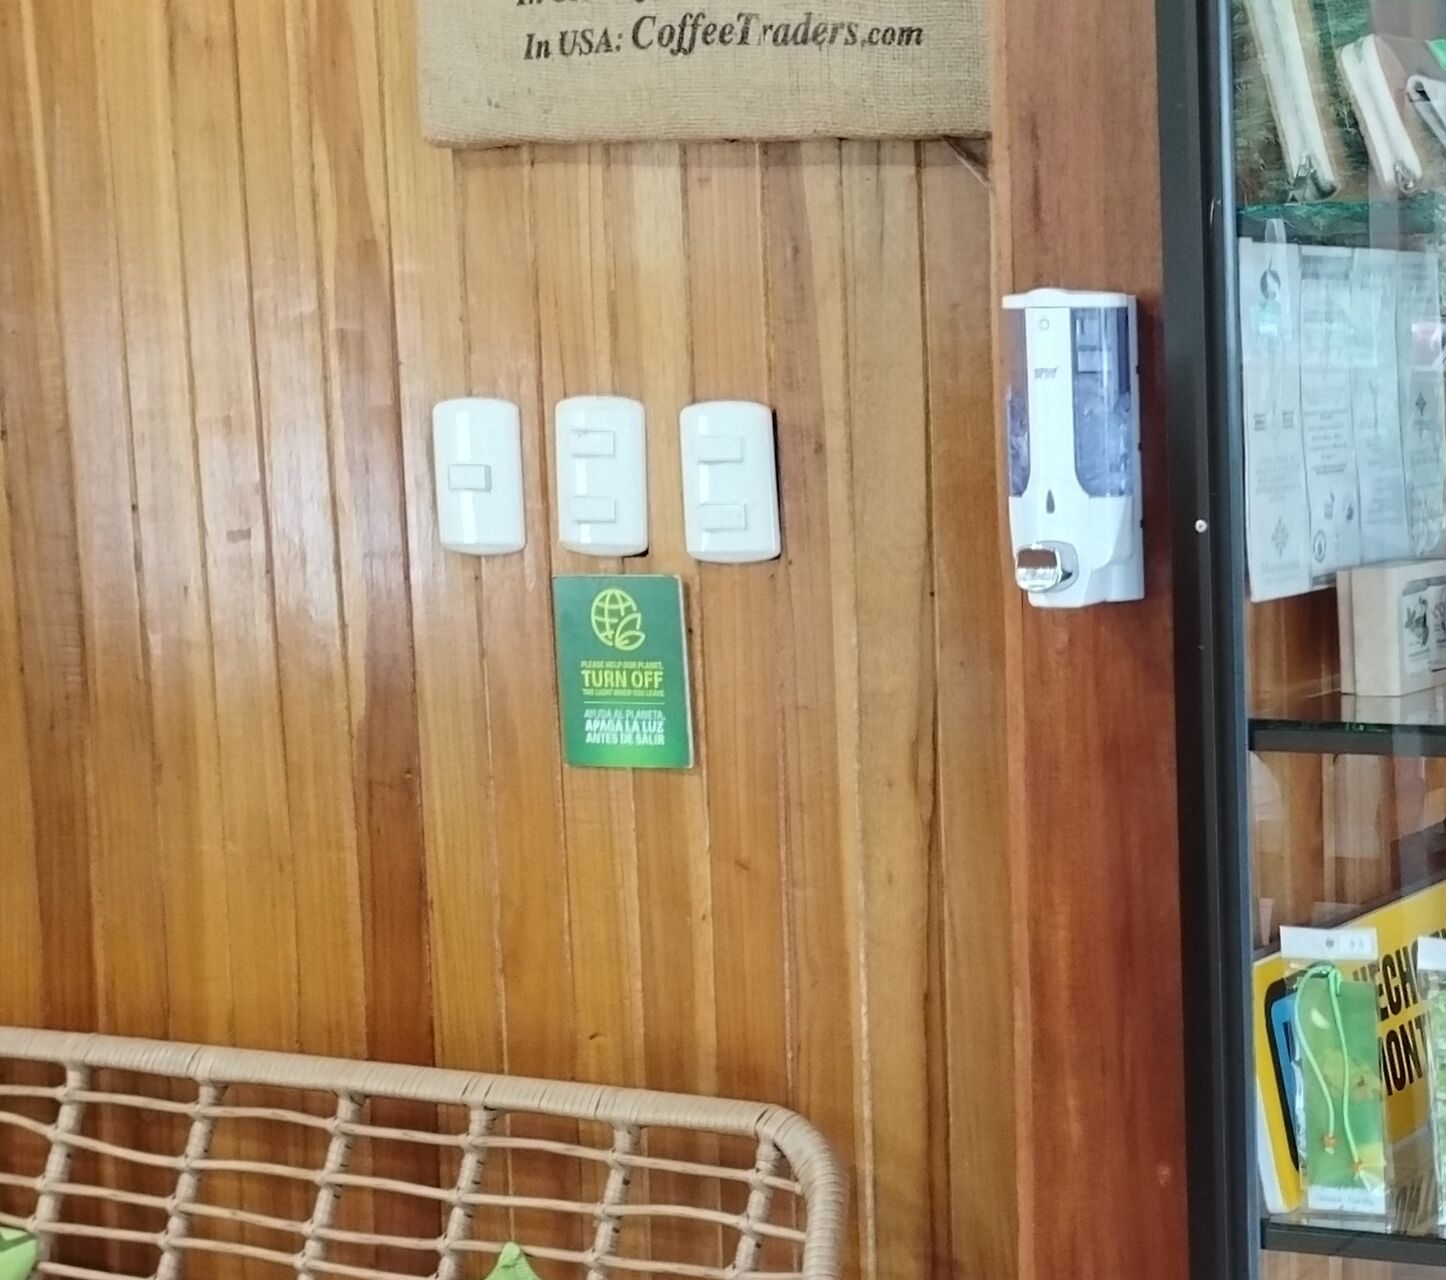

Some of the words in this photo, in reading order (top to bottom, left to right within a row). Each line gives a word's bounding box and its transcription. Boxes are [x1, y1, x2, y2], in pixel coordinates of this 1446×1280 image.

[524, 33, 550, 60] In
[558, 28, 622, 56] USA:
[631, 12, 924, 56] CoffeeTraders.com
[581, 670, 627, 688] TURN
[631, 671, 663, 688] OFF
[585, 720, 623, 732] APAGA
[625, 720, 640, 732] LA
[642, 721, 664, 733] LUZ
